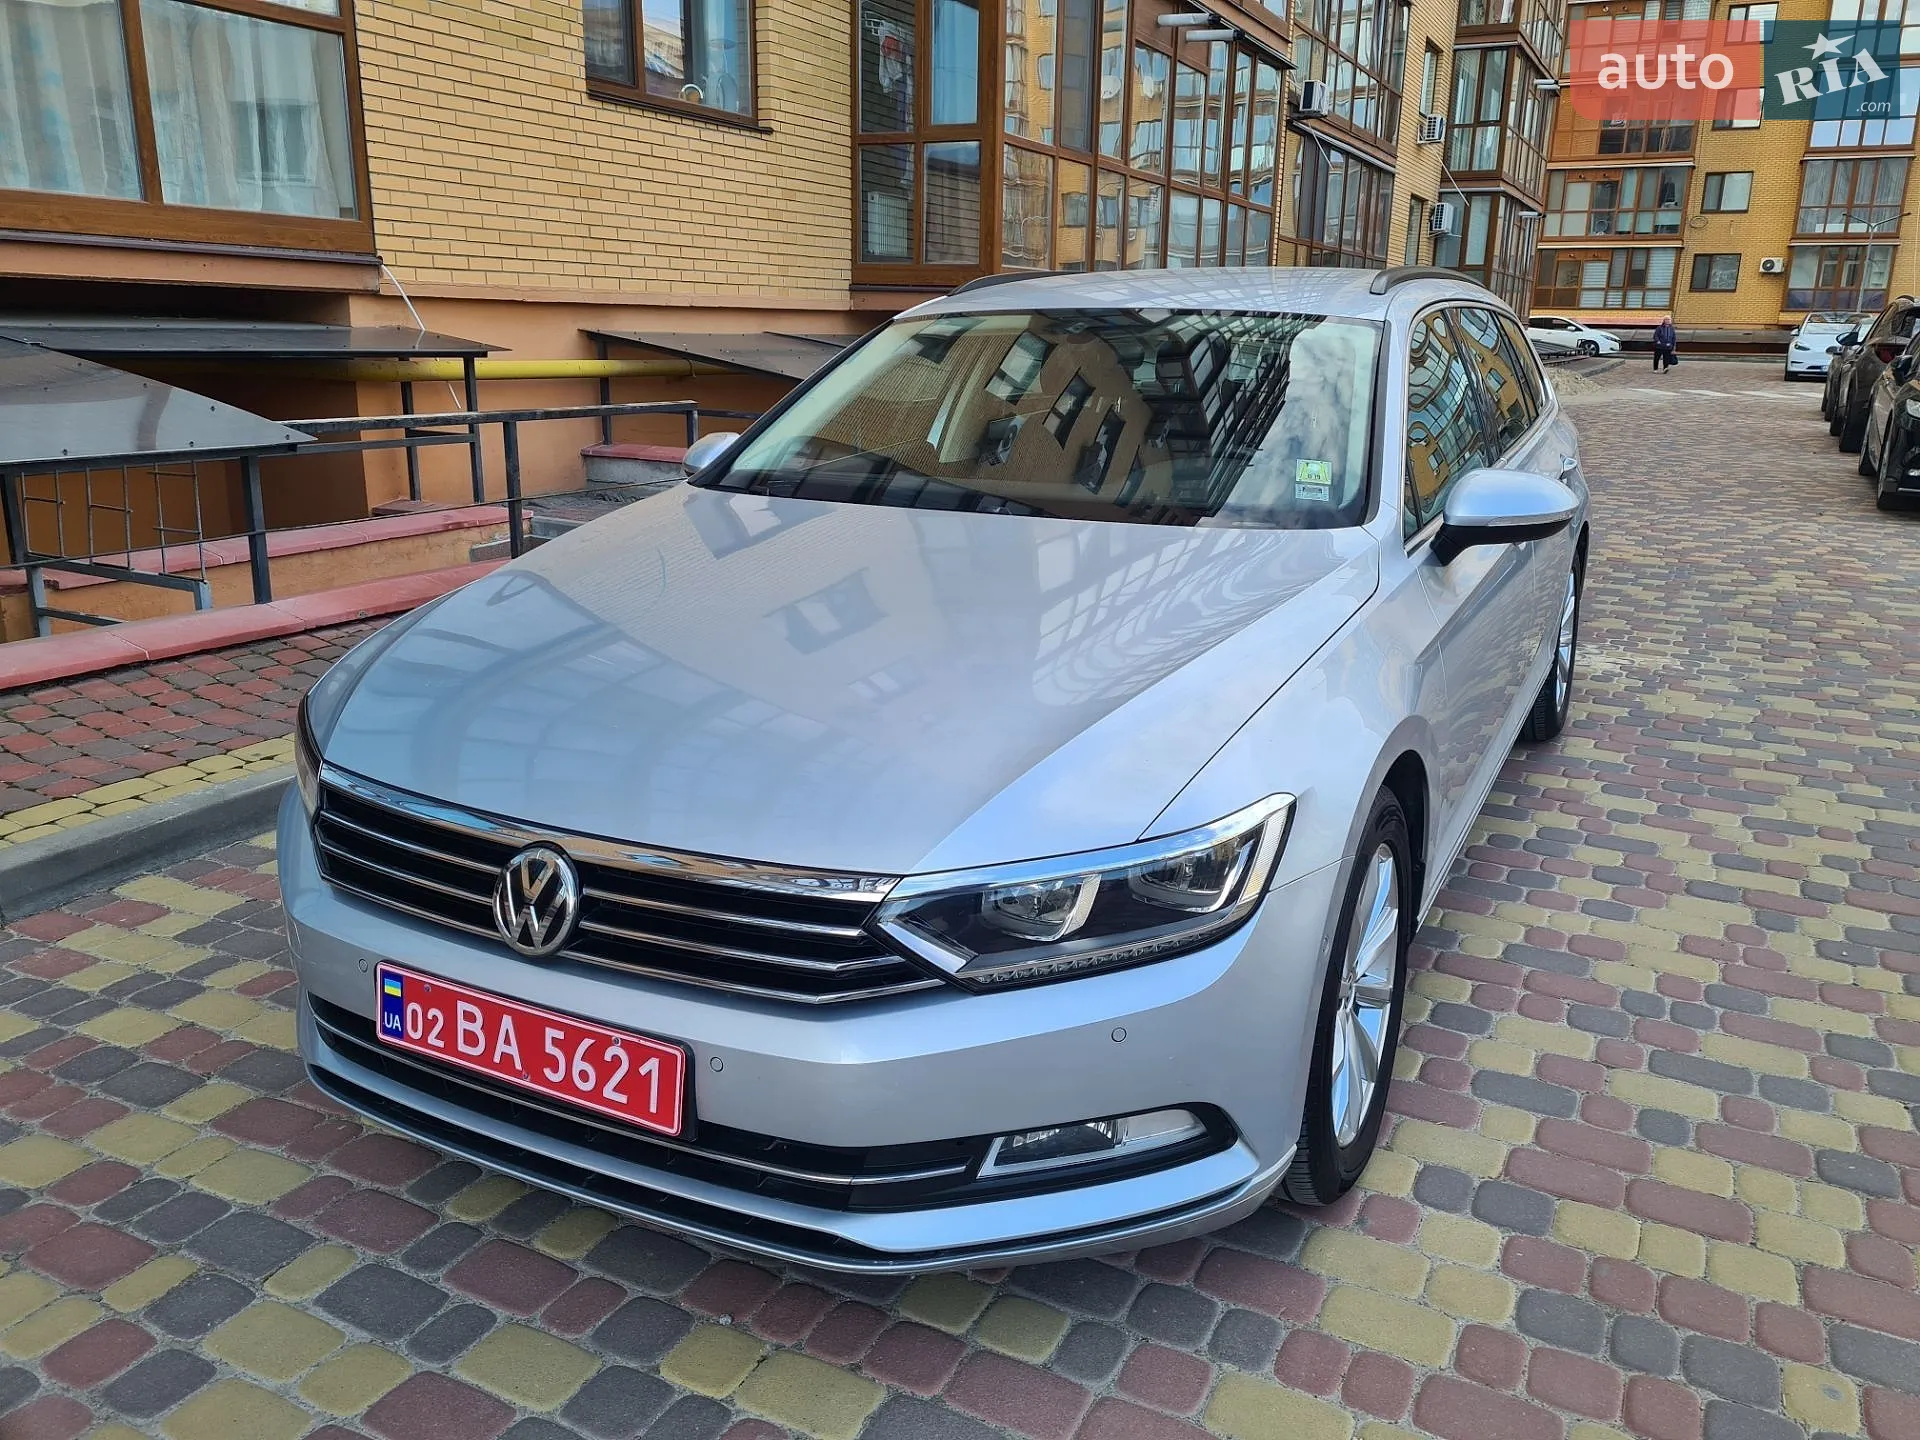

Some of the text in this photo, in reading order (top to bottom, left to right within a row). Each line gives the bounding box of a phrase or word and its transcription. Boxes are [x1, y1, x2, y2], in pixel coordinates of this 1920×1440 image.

[384, 1011, 402, 1032] UA
[406, 1000, 660, 1114] 02 BA 5621
